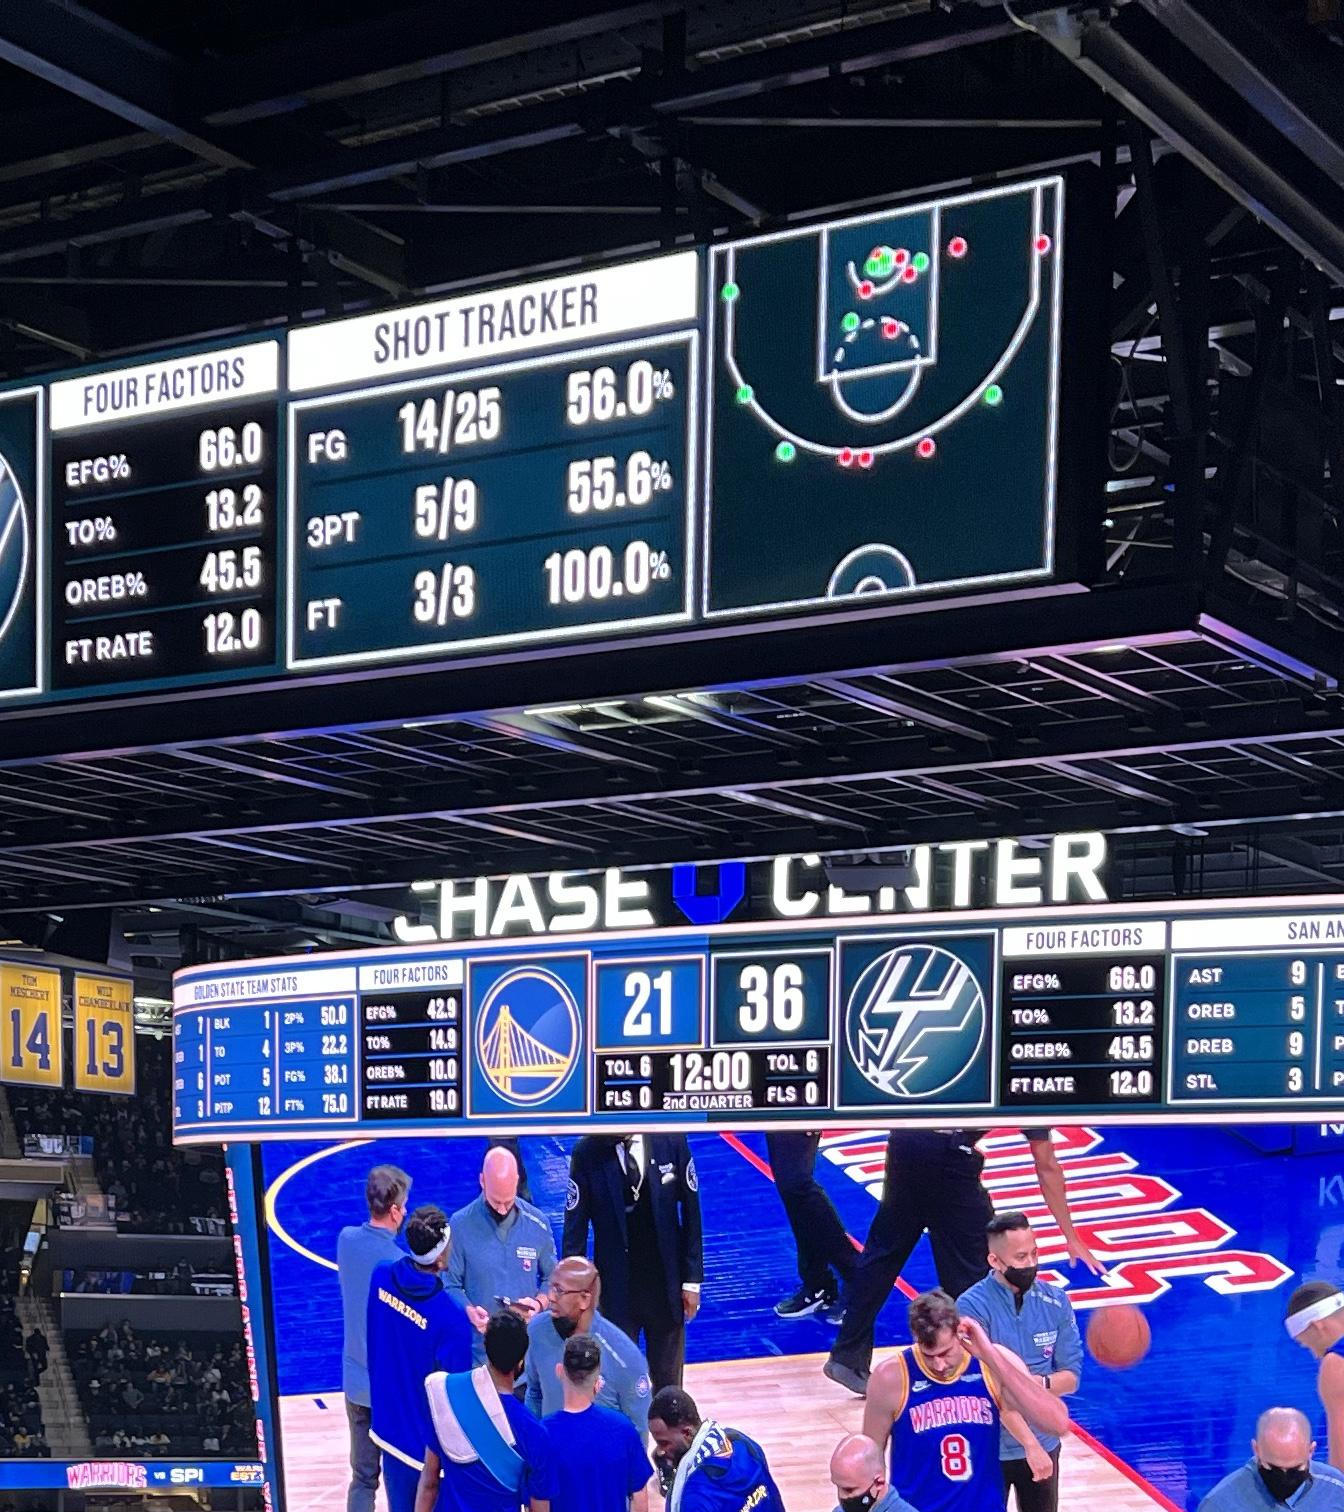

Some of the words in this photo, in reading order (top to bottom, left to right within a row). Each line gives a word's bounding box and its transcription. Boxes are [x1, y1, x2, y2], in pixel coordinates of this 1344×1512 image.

[373, 311, 450, 364] SHOT
[459, 282, 599, 349] TRACKER
[83, 377, 139, 417] FOUR
[145, 356, 246, 405] FACTORS
[307, 429, 347, 464] FG
[398, 386, 502, 454] 14/25
[566, 359, 674, 426] 56.0%
[66, 454, 130, 488] EFG%
[199, 421, 262, 472] 66.0
[65, 517, 115, 546] TO%
[205, 484, 262, 532] 13.2
[306, 511, 359, 548] 3PT
[414, 477, 477, 540] 5/9
[567, 450, 672, 514] 55.6%
[65, 571, 148, 605] OREB%
[199, 546, 261, 594] 45.5
[306, 598, 343, 631] FT
[413, 562, 476, 626] 3/3
[543, 540, 670, 605] 100.0%
[65, 638, 93, 665] FT
[95, 631, 154, 661] RATE
[203, 607, 260, 655] 12.0
[394, 867, 656, 942] CHASE
[1287, 920, 1321, 941] SAN
[622, 969, 672, 1037] 21
[738, 962, 805, 1034] 36
[1188, 967, 1223, 985] AST
[1290, 960, 1306, 985] 9
[1187, 1002, 1236, 1019] OREB
[1290, 996, 1305, 1021] 5
[11, 1008, 51, 1070] 14
[86, 1018, 124, 1078] 13
[668, 1050, 750, 1091] 12:00
[662, 1093, 688, 1110] 2nd
[689, 1092, 753, 1110] QUARTER
[377, 1286, 428, 1331] WARRIORS
[910, 1395, 993, 1434] WARRIORS
[939, 1432, 974, 1482] 8
